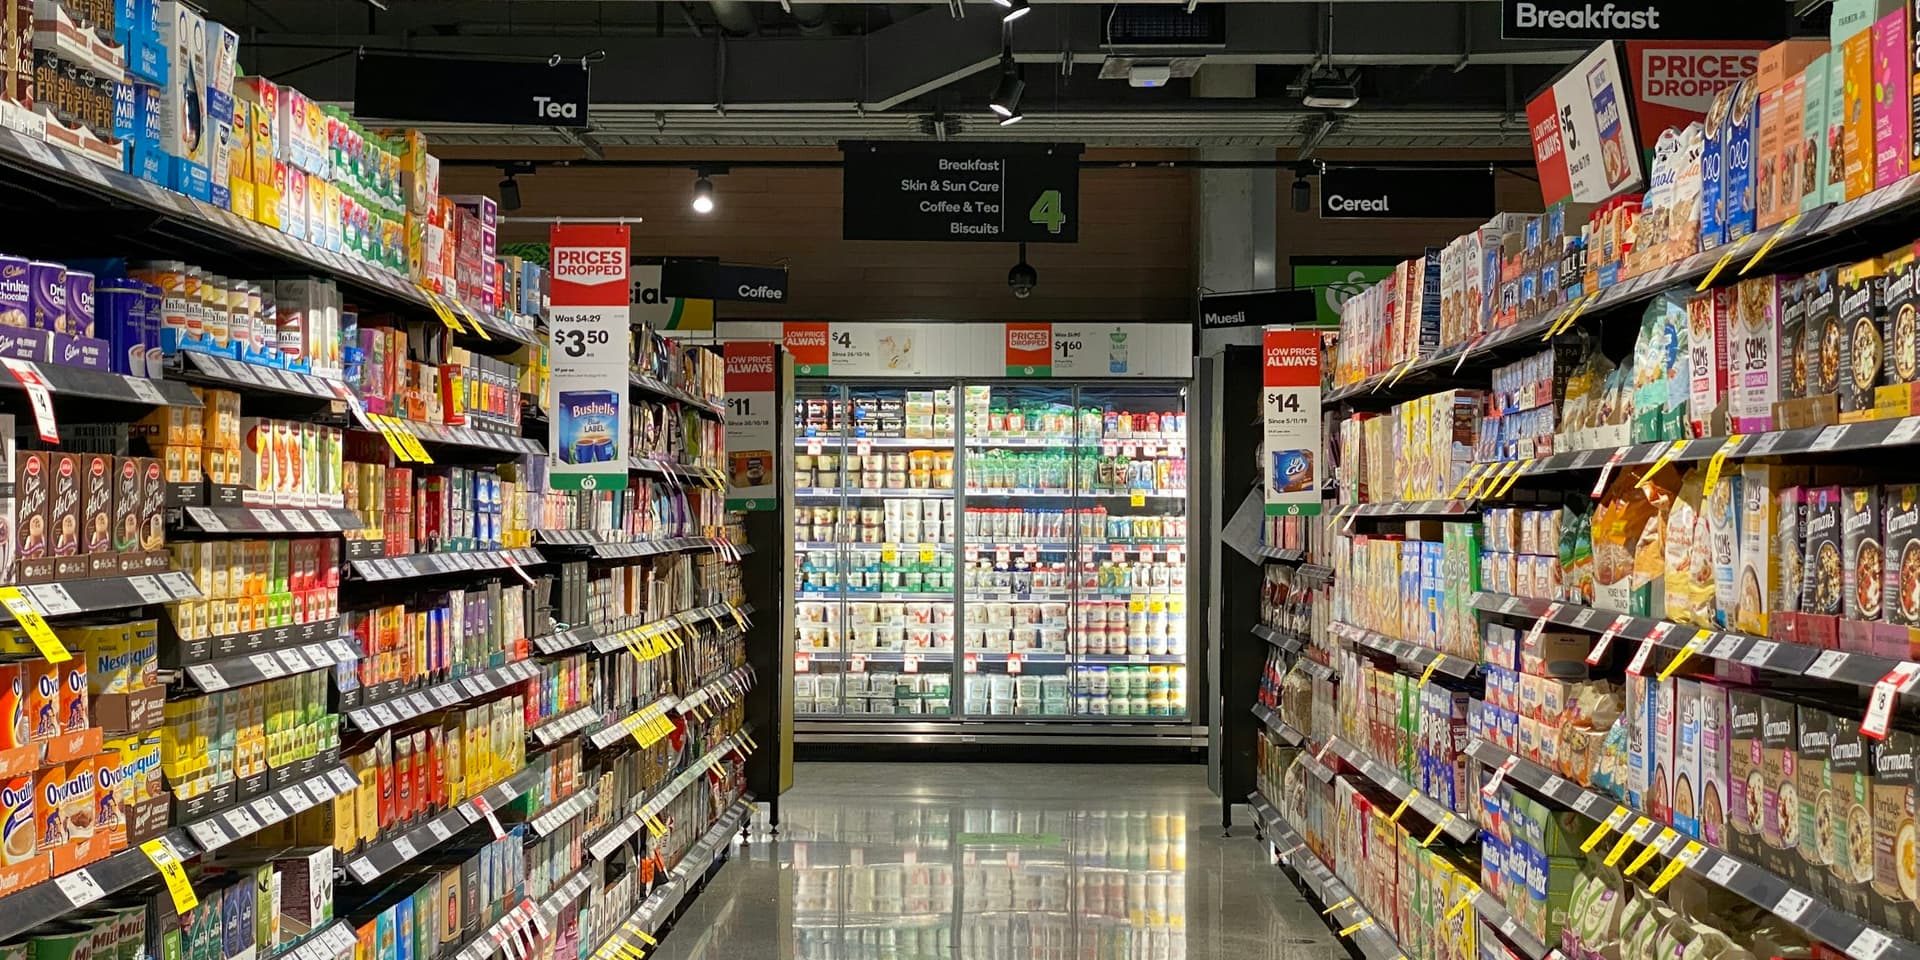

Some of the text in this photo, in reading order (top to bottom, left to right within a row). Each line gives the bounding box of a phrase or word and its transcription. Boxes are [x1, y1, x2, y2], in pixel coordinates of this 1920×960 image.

[1516, 3, 1660, 29] Breakfast
[1648, 55, 1757, 78] PRICES
[533, 96, 577, 118] Tea
[1560, 104, 1577, 150] $5
[1537, 132, 1561, 163] ALWAYS
[939, 158, 999, 171] Breakfast
[901, 179, 999, 191] Skin & Sun Care
[920, 200, 999, 213] Coffee & Tea
[1328, 194, 1389, 211] Cereal
[1029, 190, 1066, 233] 4
[950, 222, 999, 234] Biscuits
[558, 251, 622, 264] PRICES
[558, 265, 622, 276] DROPPED
[738, 284, 783, 299] Coffee
[576, 314, 601, 323] $4.29
[1205, 311, 1245, 325] Muesli
[786, 338, 826, 346] ALWAYS
[832, 332, 851, 349] $4
[1011, 332, 1047, 340] PRICES
[1290, 348, 1317, 356] PRICE
[1267, 356, 1317, 366] ALWAYS
[727, 363, 773, 373] ALWAYS
[727, 398, 750, 416] $11
[1268, 393, 1300, 413] $14
[572, 402, 615, 418] Bushells
[584, 425, 605, 433] LABEL
